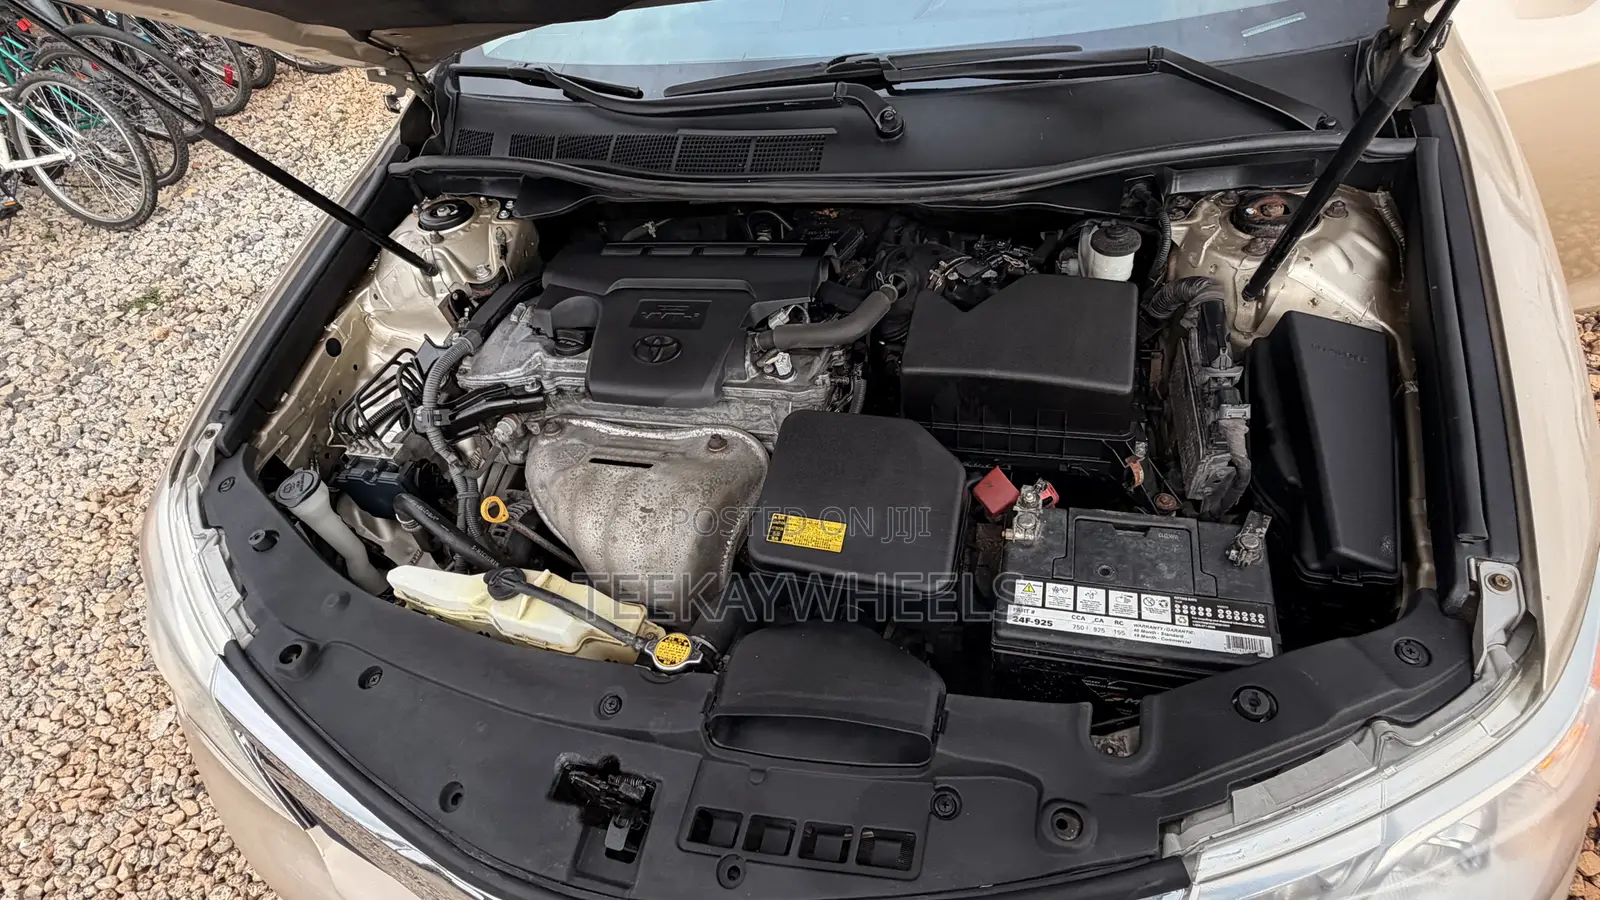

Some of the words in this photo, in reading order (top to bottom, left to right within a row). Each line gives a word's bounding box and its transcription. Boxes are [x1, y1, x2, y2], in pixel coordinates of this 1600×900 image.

[1012, 615, 1053, 627] 24F-925
[1071, 614, 1086, 622] CCA
[1094, 617, 1105, 625] CA
[1114, 619, 1124, 627] RC
